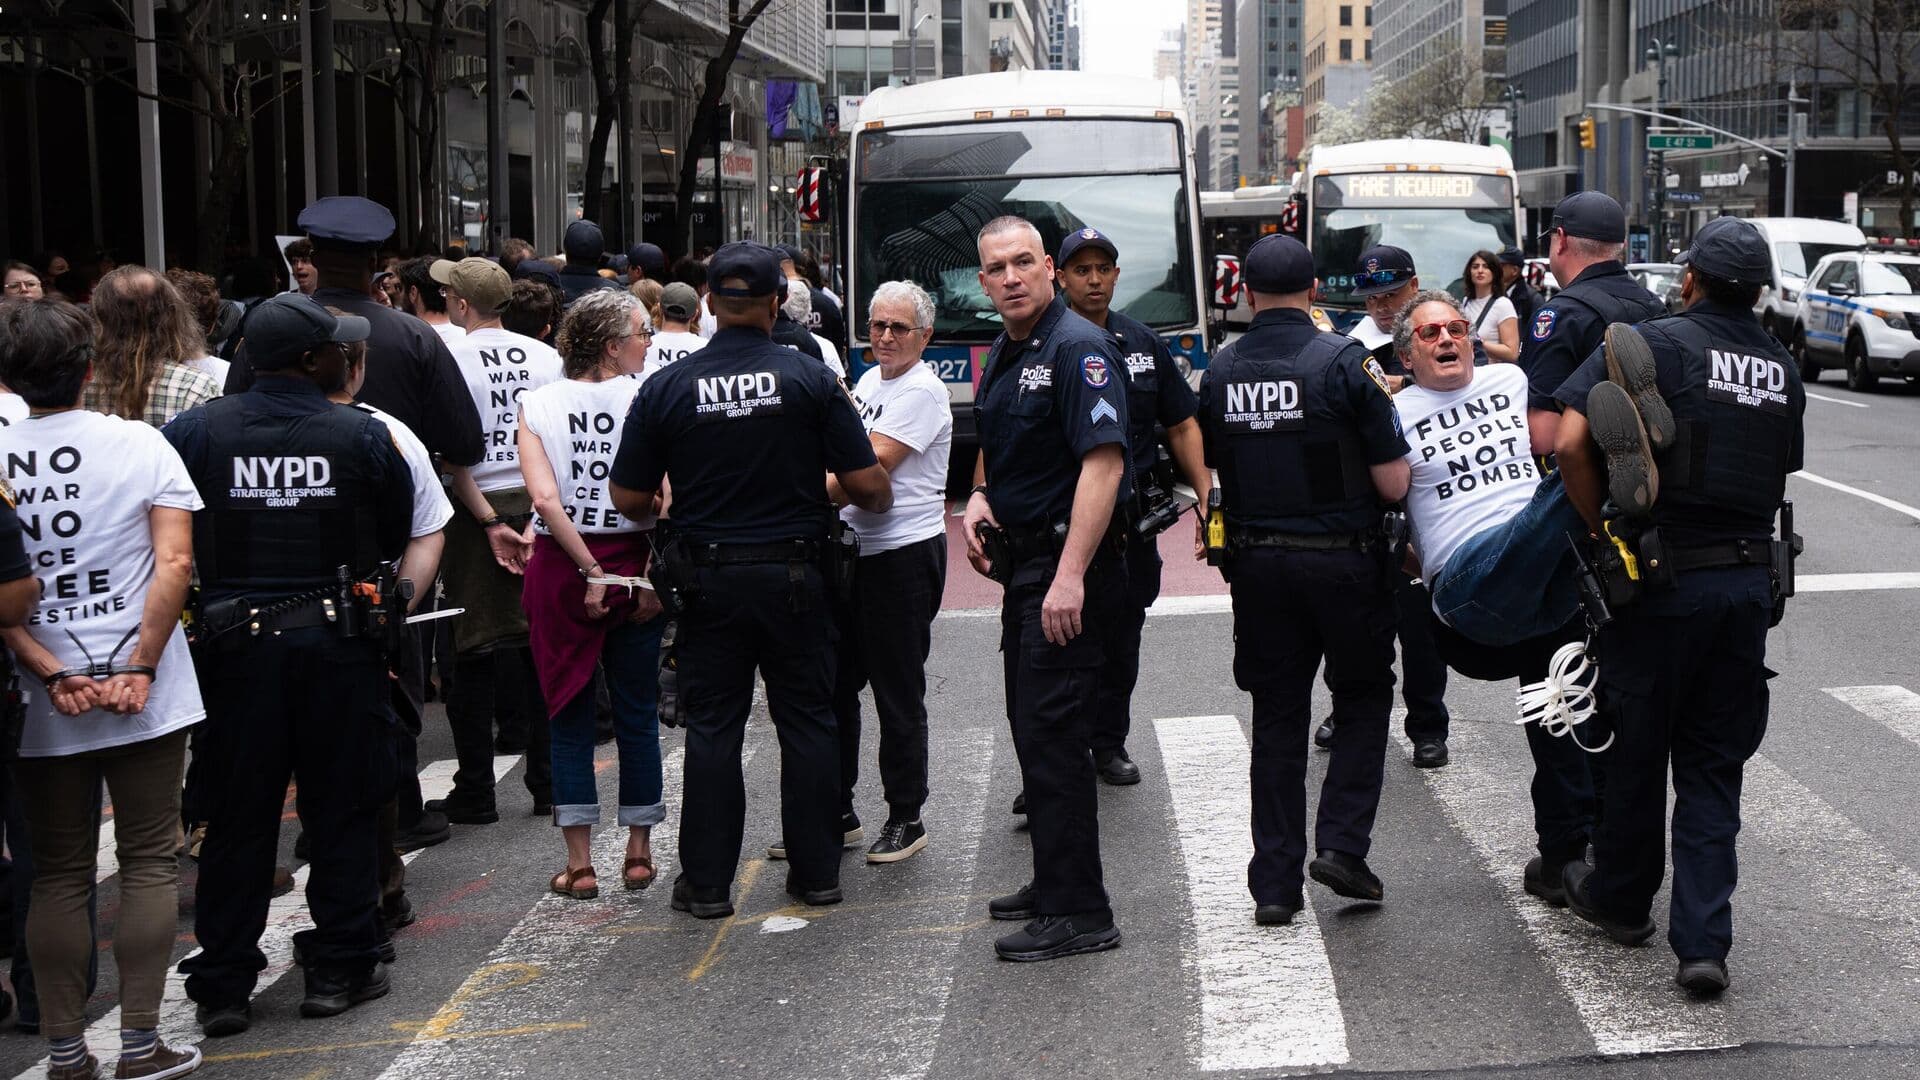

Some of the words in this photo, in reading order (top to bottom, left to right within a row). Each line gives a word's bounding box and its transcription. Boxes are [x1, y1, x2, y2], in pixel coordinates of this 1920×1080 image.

[1666, 138, 1671, 147] E
[1674, 138, 1684, 147] 47
[1687, 138, 1695, 147] St
[1350, 176, 1389, 197] FARE
[1394, 176, 1473, 197] REQUIRED
[807, 311, 821, 324] PD
[479, 347, 527, 367] NO
[488, 370, 530, 384] WAR
[1711, 349, 1785, 392] NYPD
[697, 371, 776, 404] NYPD
[1226, 380, 1299, 413] NYPD
[1707, 379, 1750, 395] STRATEGIC
[1751, 387, 1788, 404] RESPONSE
[696, 401, 738, 413] STRATEGIC
[740, 396, 782, 409] RESPONSE
[1736, 394, 1762, 407] GROUP
[497, 412, 520, 425] IC
[568, 412, 615, 434] NO
[726, 407, 753, 418] GROUP
[1224, 412, 1262, 422] STRATEGIC
[1263, 410, 1304, 421] RESPONSE
[1415, 393, 1511, 441] FUND
[1249, 420, 1275, 430] GROUP
[573, 440, 612, 455] WAR
[1421, 415, 1524, 462] PEOPLE
[7, 445, 82, 479] NO
[1446, 436, 1517, 477] NOT
[233, 455, 331, 488] NYPD
[571, 460, 609, 481] NO
[1435, 462, 1533, 500] BOMBS
[15, 483, 81, 506] WAR
[229, 488, 282, 498] STRATEGIC
[285, 487, 337, 498] RESPONSE
[266, 497, 300, 507] GROUP
[575, 486, 601, 501] CE
[563, 504, 621, 528] REE
[27, 547, 77, 568] CE
[40, 568, 111, 601] EE
[29, 596, 126, 626] ESTINE
